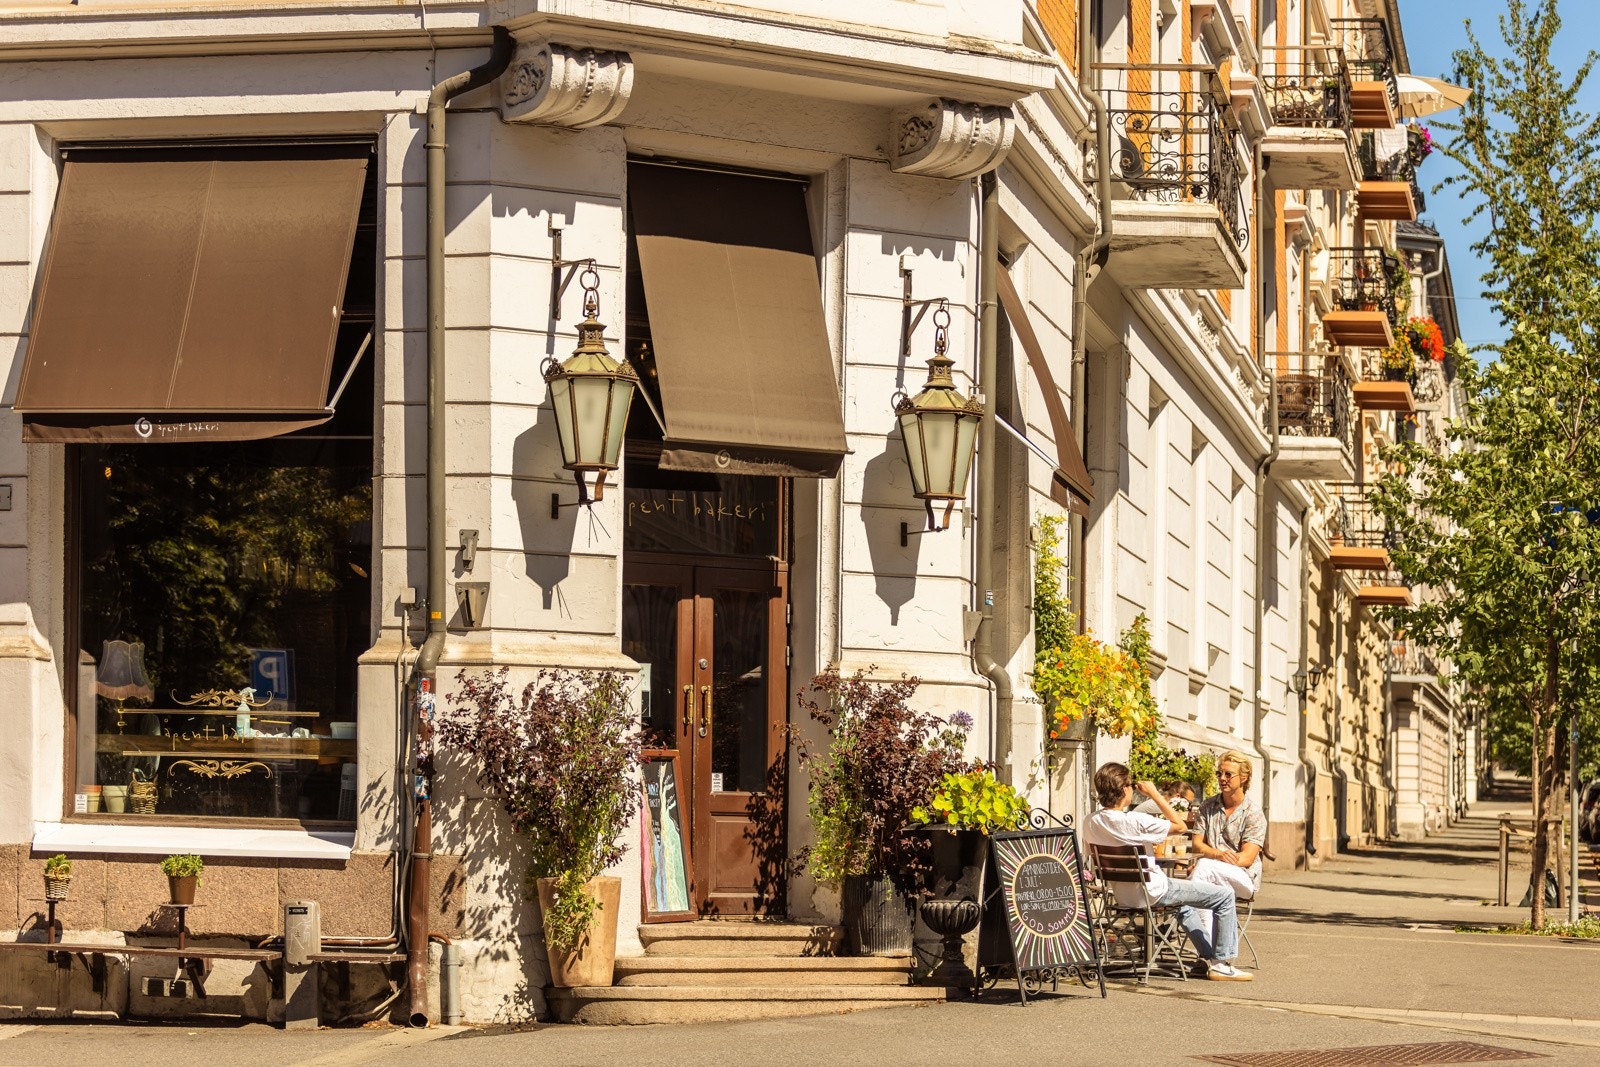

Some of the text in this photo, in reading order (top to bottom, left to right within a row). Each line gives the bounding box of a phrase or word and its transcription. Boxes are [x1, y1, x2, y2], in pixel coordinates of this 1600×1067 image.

[188, 423, 219, 432] bakeri
[628, 493, 766, 526] pent bakeri
[164, 718, 279, 751] åpent baei
[1021, 911, 1044, 932] GOD
